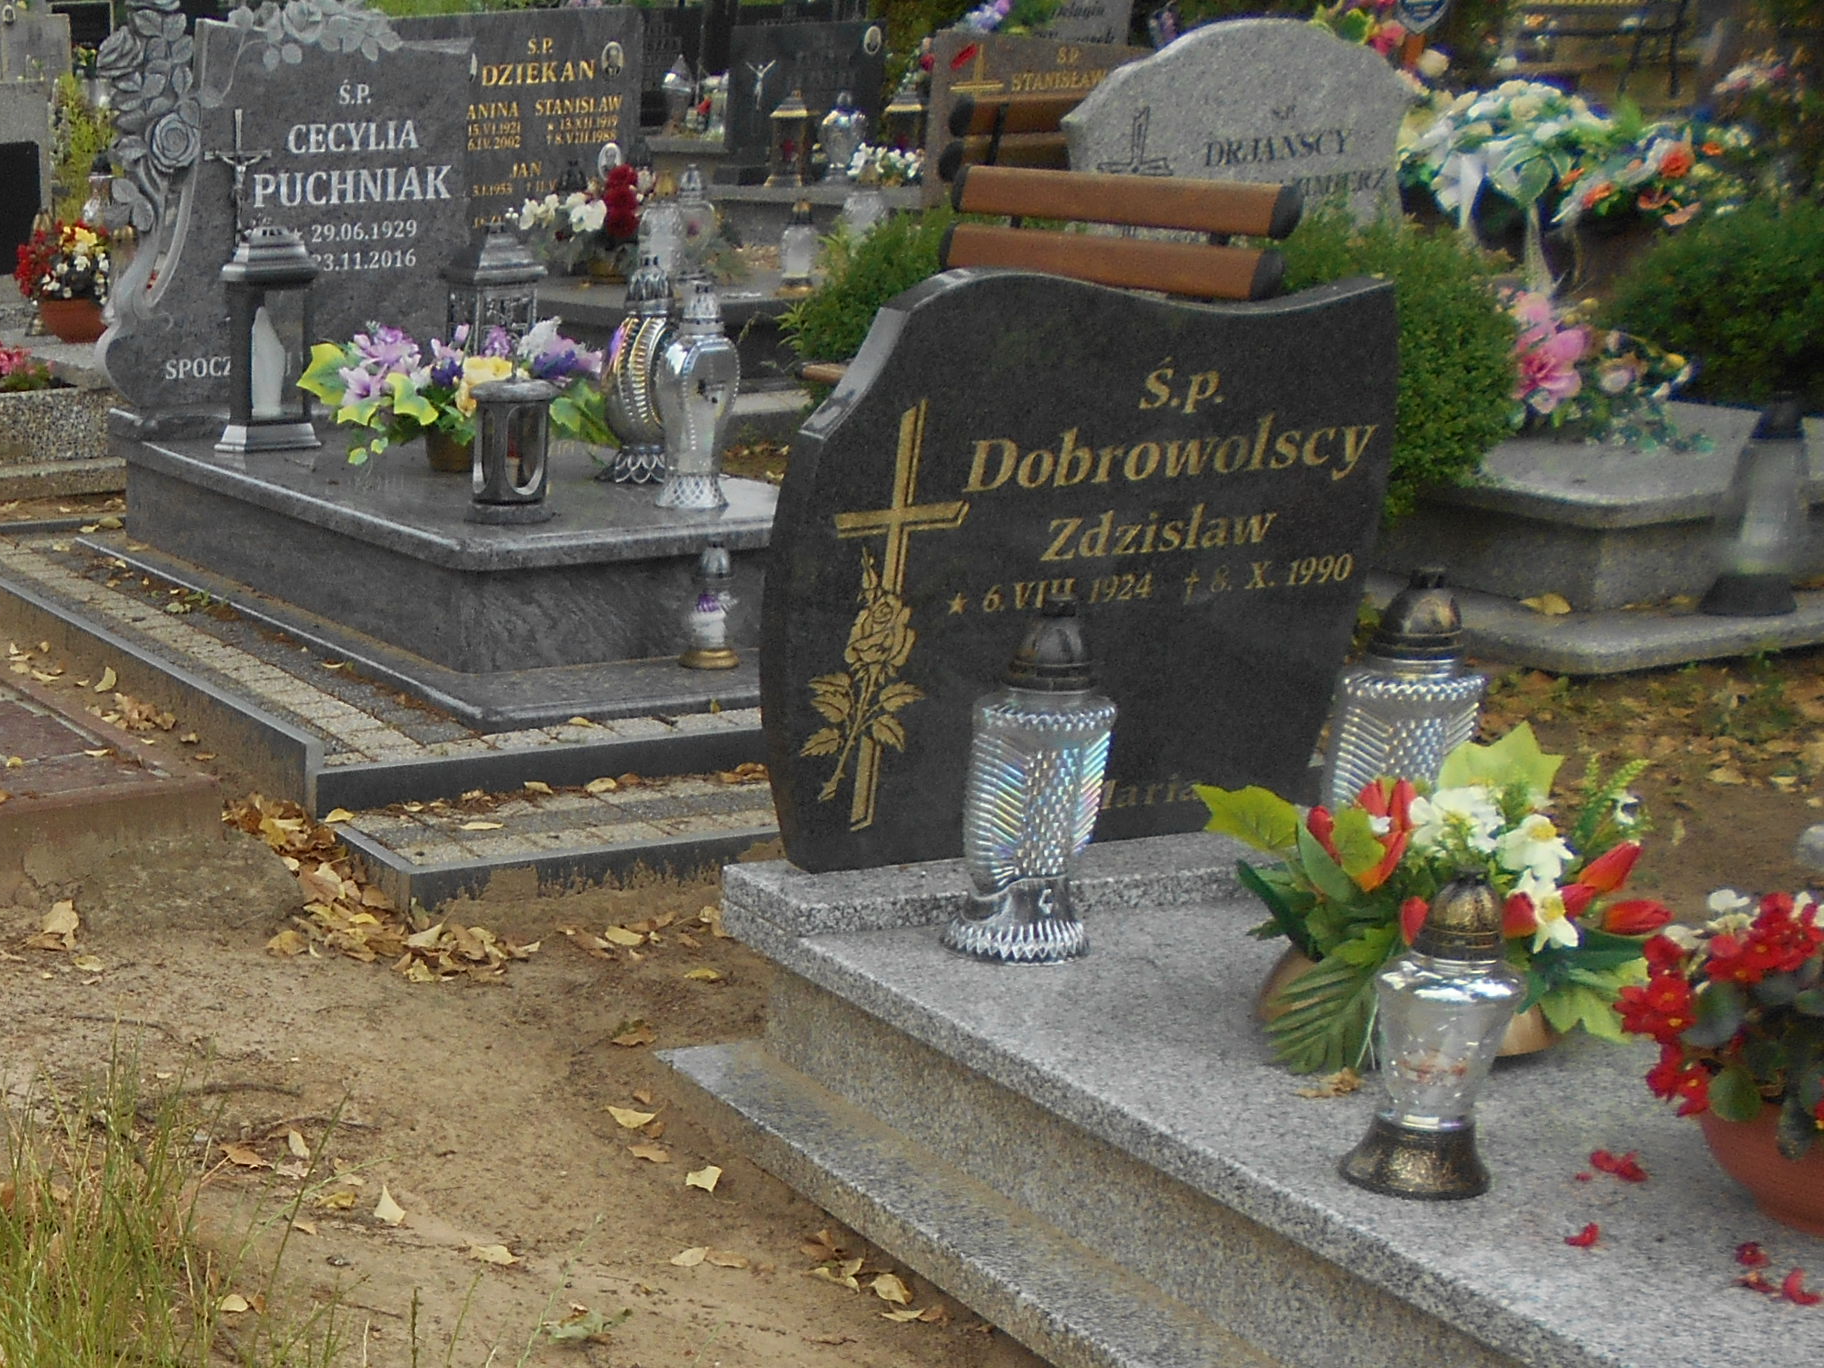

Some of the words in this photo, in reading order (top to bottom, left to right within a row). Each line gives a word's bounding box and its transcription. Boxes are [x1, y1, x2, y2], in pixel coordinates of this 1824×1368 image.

[481, 59, 596, 86] DZIEKAN
[466, 101, 520, 120] ANINA
[287, 119, 420, 154] CECYLIA
[253, 164, 453, 208] PUCHNIAK
[310, 219, 417, 243] 29.06.1929
[1139, 356, 1228, 414] Ś.p.
[962, 411, 1379, 494] Dobrowolscy
[1087, 571, 1153, 604] 1924
[1286, 553, 1355, 586] 1990
